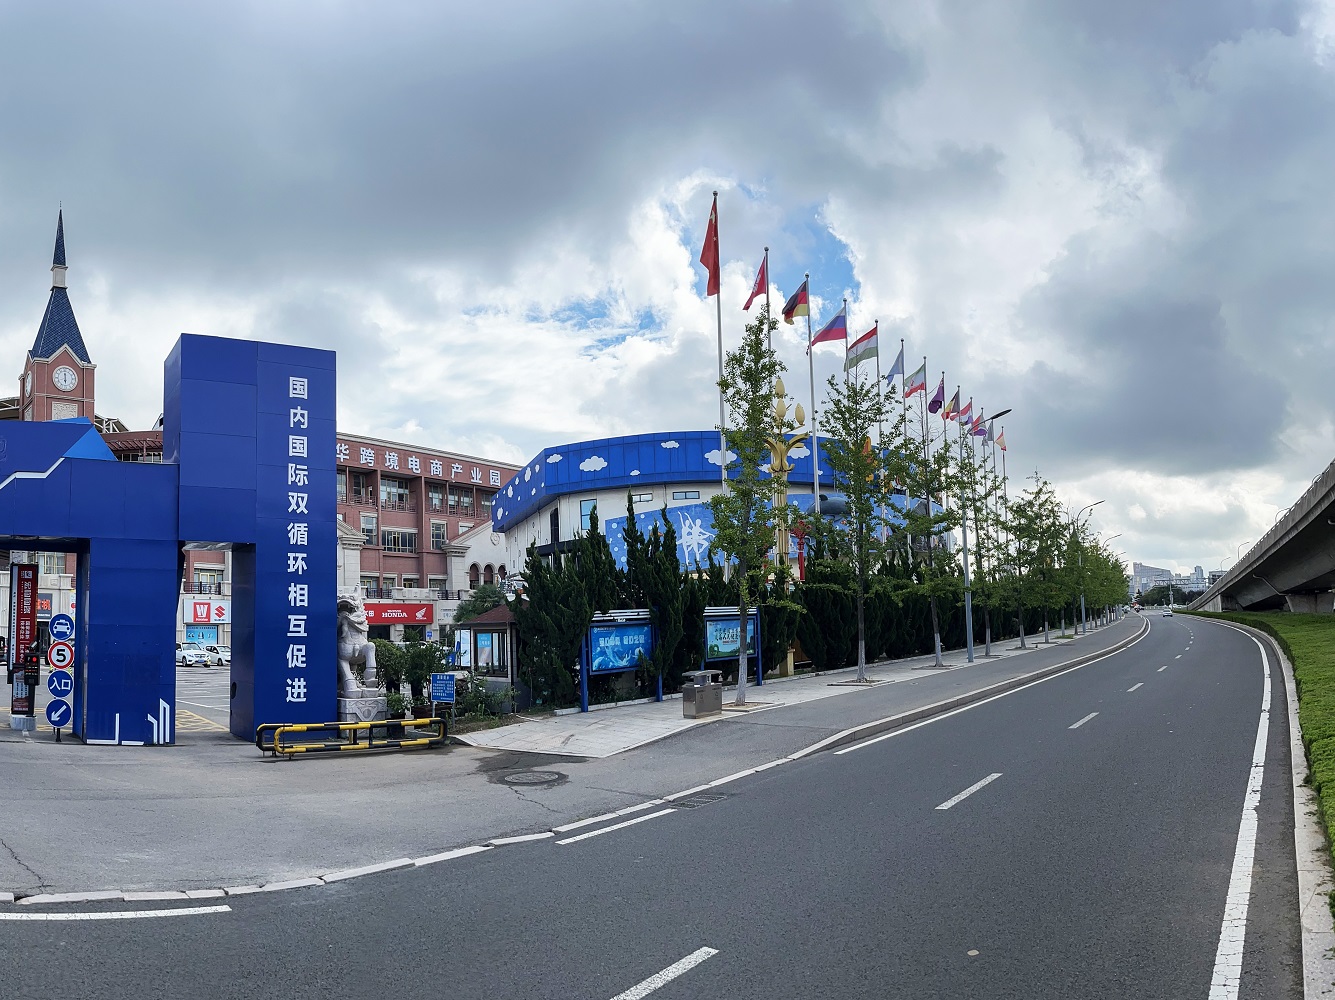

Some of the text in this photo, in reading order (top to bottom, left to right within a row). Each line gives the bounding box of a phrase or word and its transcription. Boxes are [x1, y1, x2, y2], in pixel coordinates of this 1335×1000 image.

[336, 443, 501, 487] 华跨境电商产业园
[285, 376, 309, 703] 国内国际双循环相互促进
[55, 648, 66, 663] 5
[50, 677, 71, 690] 入口
